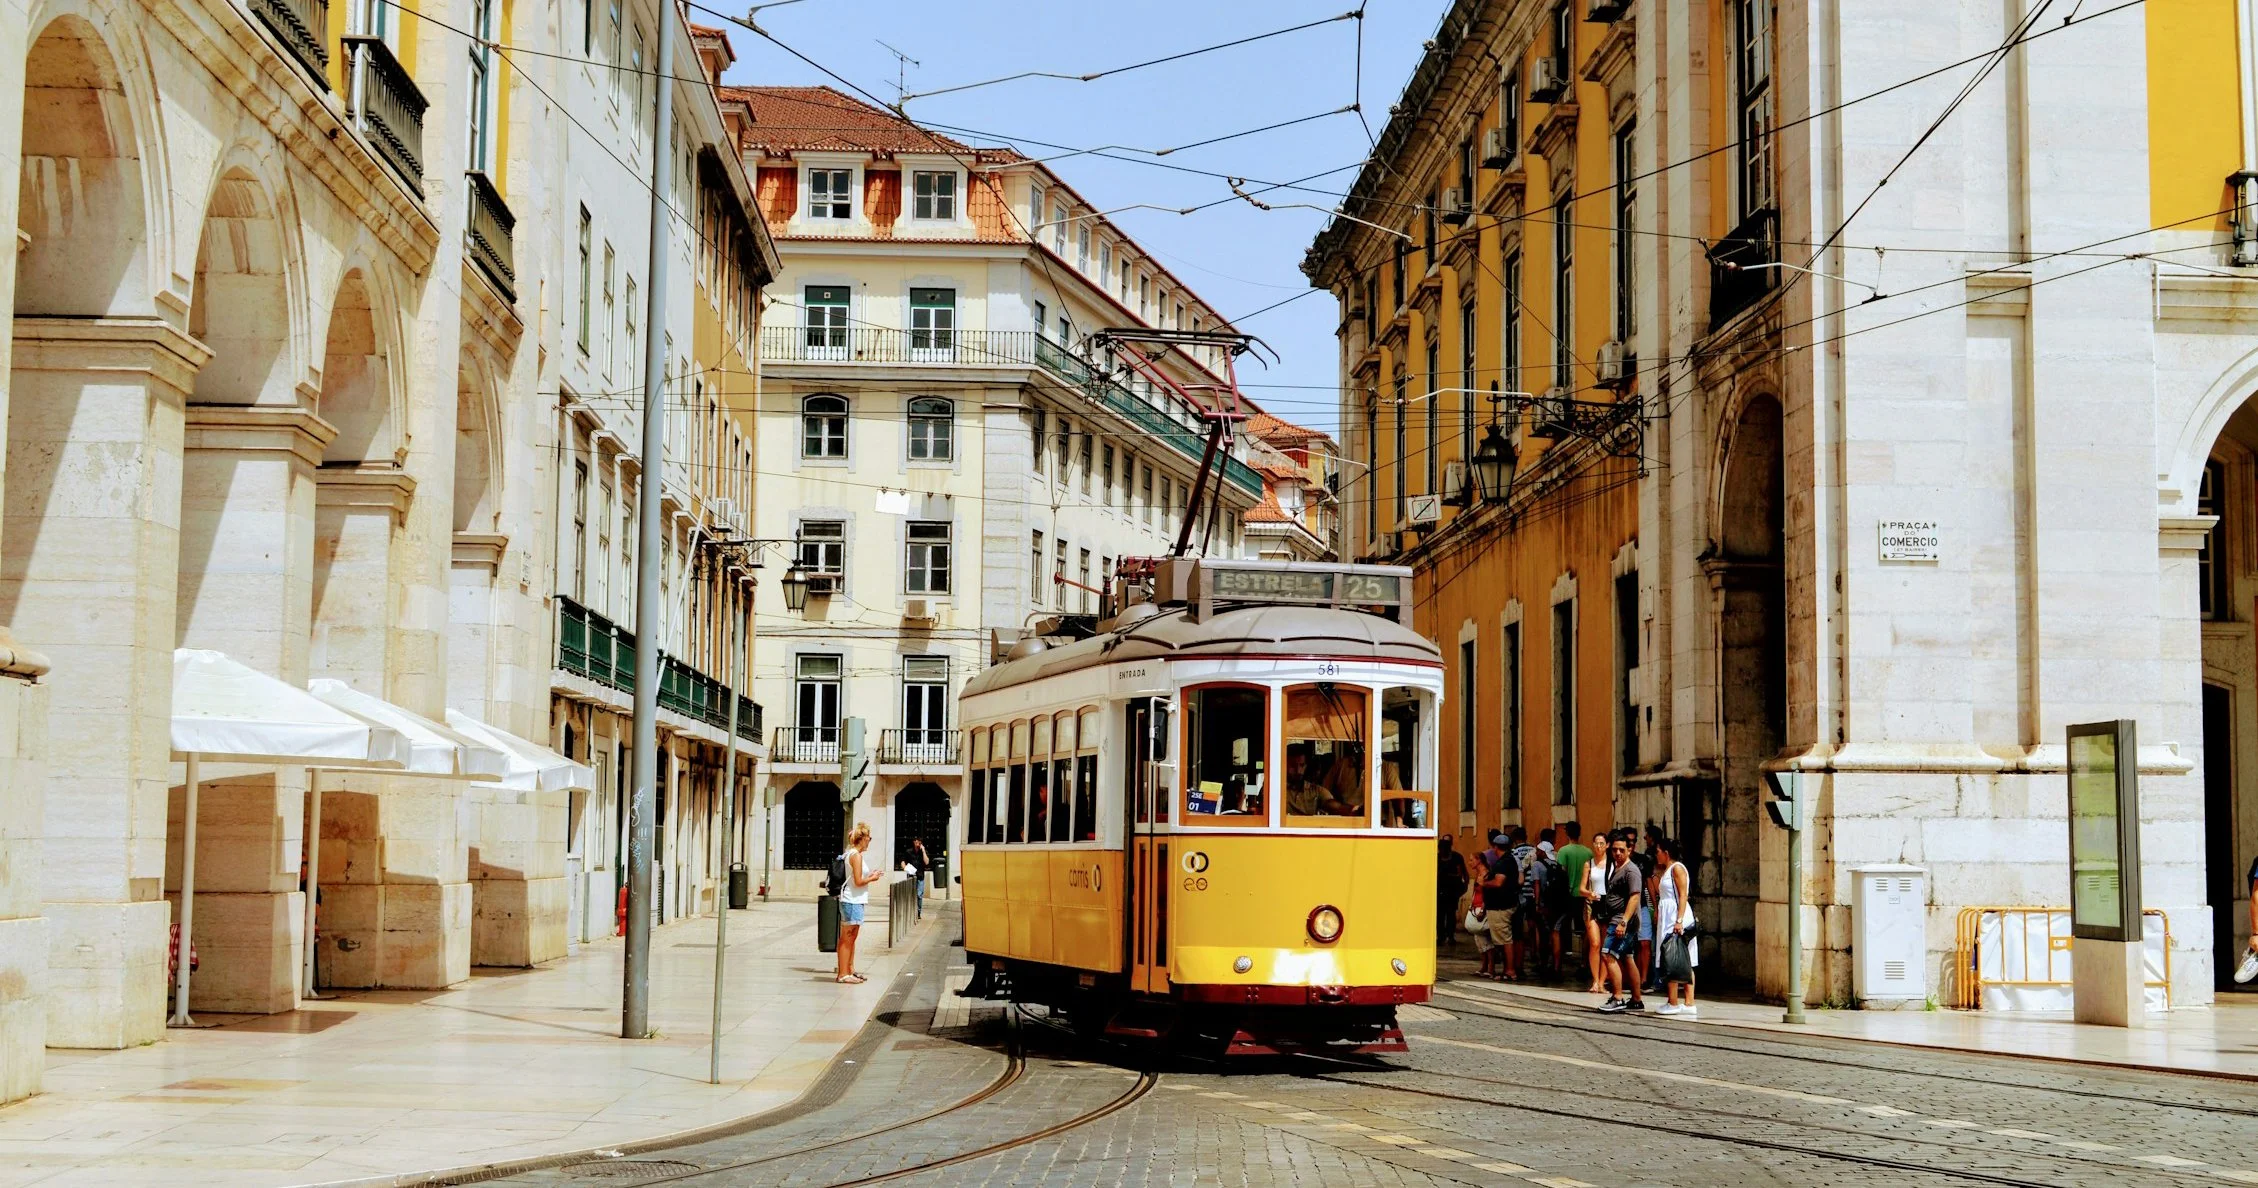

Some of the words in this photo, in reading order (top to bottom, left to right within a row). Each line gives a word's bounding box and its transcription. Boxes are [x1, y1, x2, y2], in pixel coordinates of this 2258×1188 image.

[1890, 522, 1929, 532] PRAÇA
[1882, 537, 1938, 546] COMERCIO
[1220, 573, 1324, 592] ESTRELA
[1347, 577, 1382, 599] 25
[1119, 669, 1146, 679] ENTRADA
[1318, 664, 1340, 675] 581
[1188, 802, 1200, 811] 01
